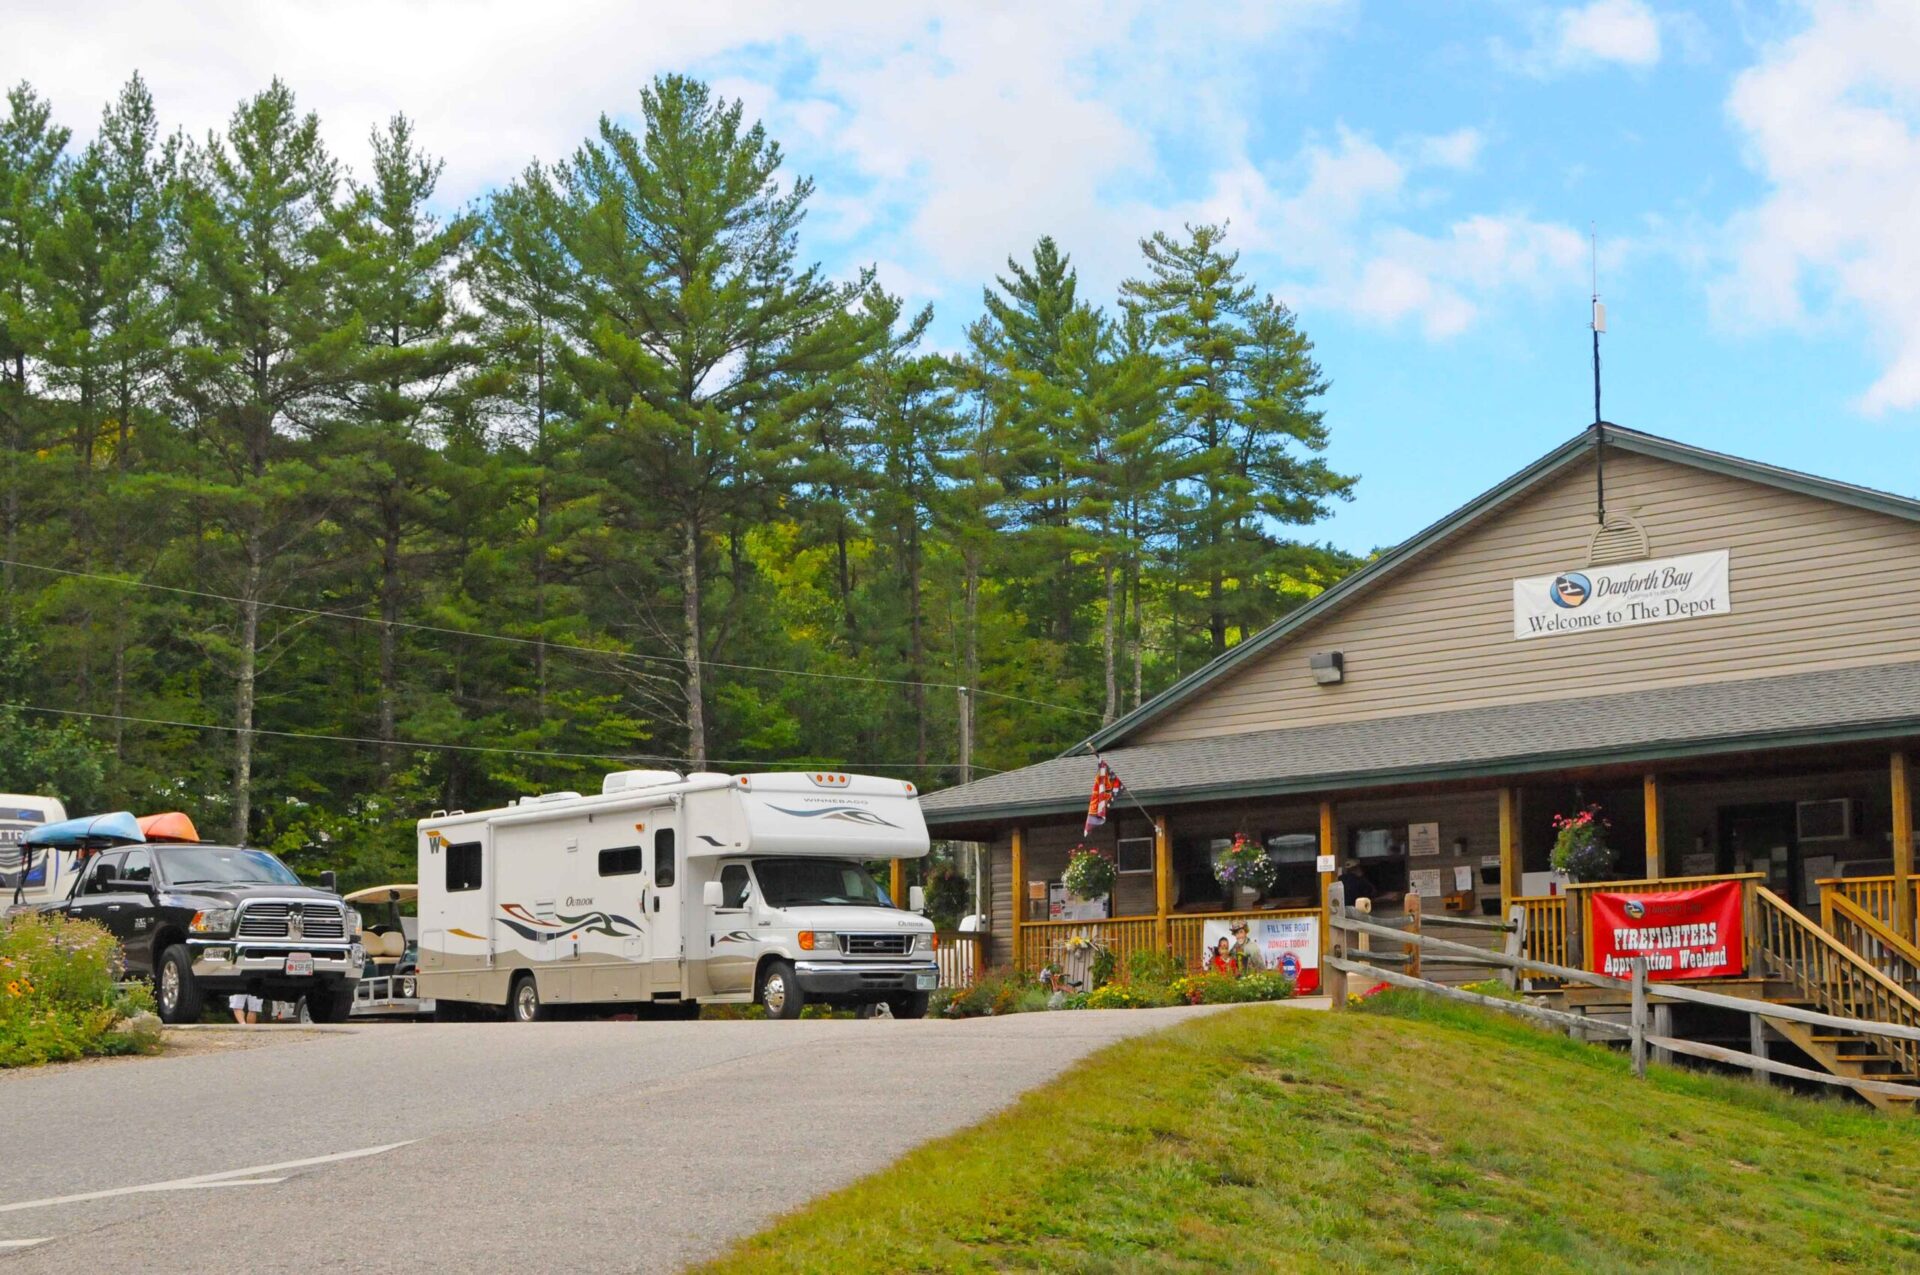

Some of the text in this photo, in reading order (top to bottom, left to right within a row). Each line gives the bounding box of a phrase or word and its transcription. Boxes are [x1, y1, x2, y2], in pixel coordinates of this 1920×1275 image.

[1597, 569, 1659, 598] Danforth
[1662, 566, 1694, 592] Bay
[1529, 597, 1716, 633] Welcome to The Depot
[428, 837, 441, 854] W
[1267, 923, 1311, 933] FILL THE BOOT
[1613, 922, 1717, 951] FIREFIGHTERS
[1268, 939, 1310, 948] DONATE TODAY!
[1679, 946, 1728, 969] Weekend
